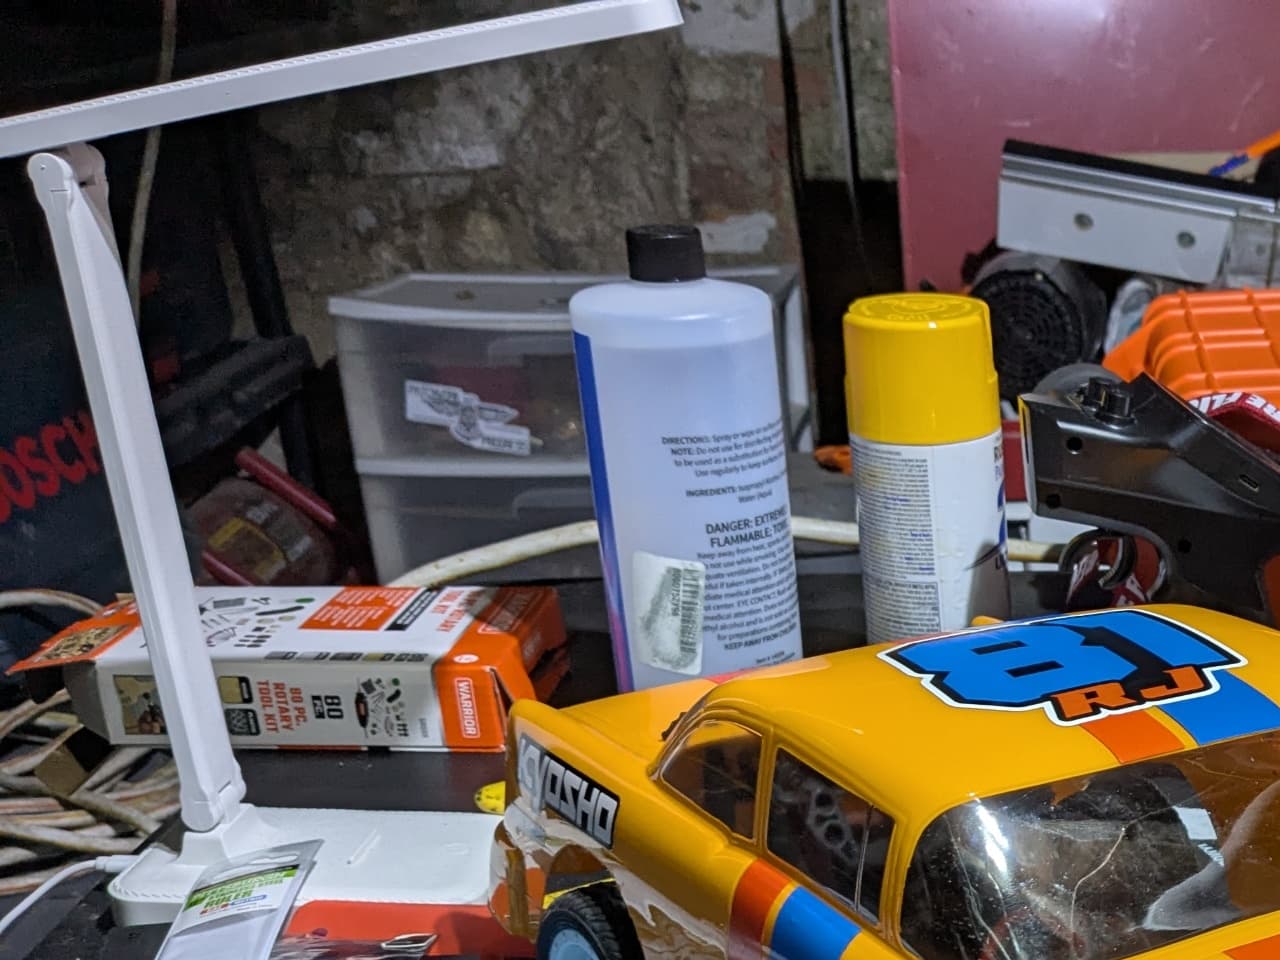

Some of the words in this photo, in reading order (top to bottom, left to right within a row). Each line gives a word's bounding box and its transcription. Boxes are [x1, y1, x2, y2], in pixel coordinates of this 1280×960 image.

[0, 408, 99, 523] OSCH
[706, 518, 753, 535] DANGER:
[897, 611, 1231, 705] 81
[257, 680, 273, 709] TOOL
[272, 682, 294, 731] ROTARY
[290, 687, 303, 704] 80
[323, 695, 345, 720] 80
[458, 681, 477, 737] WARRIOR
[264, 712, 279, 733] KIT
